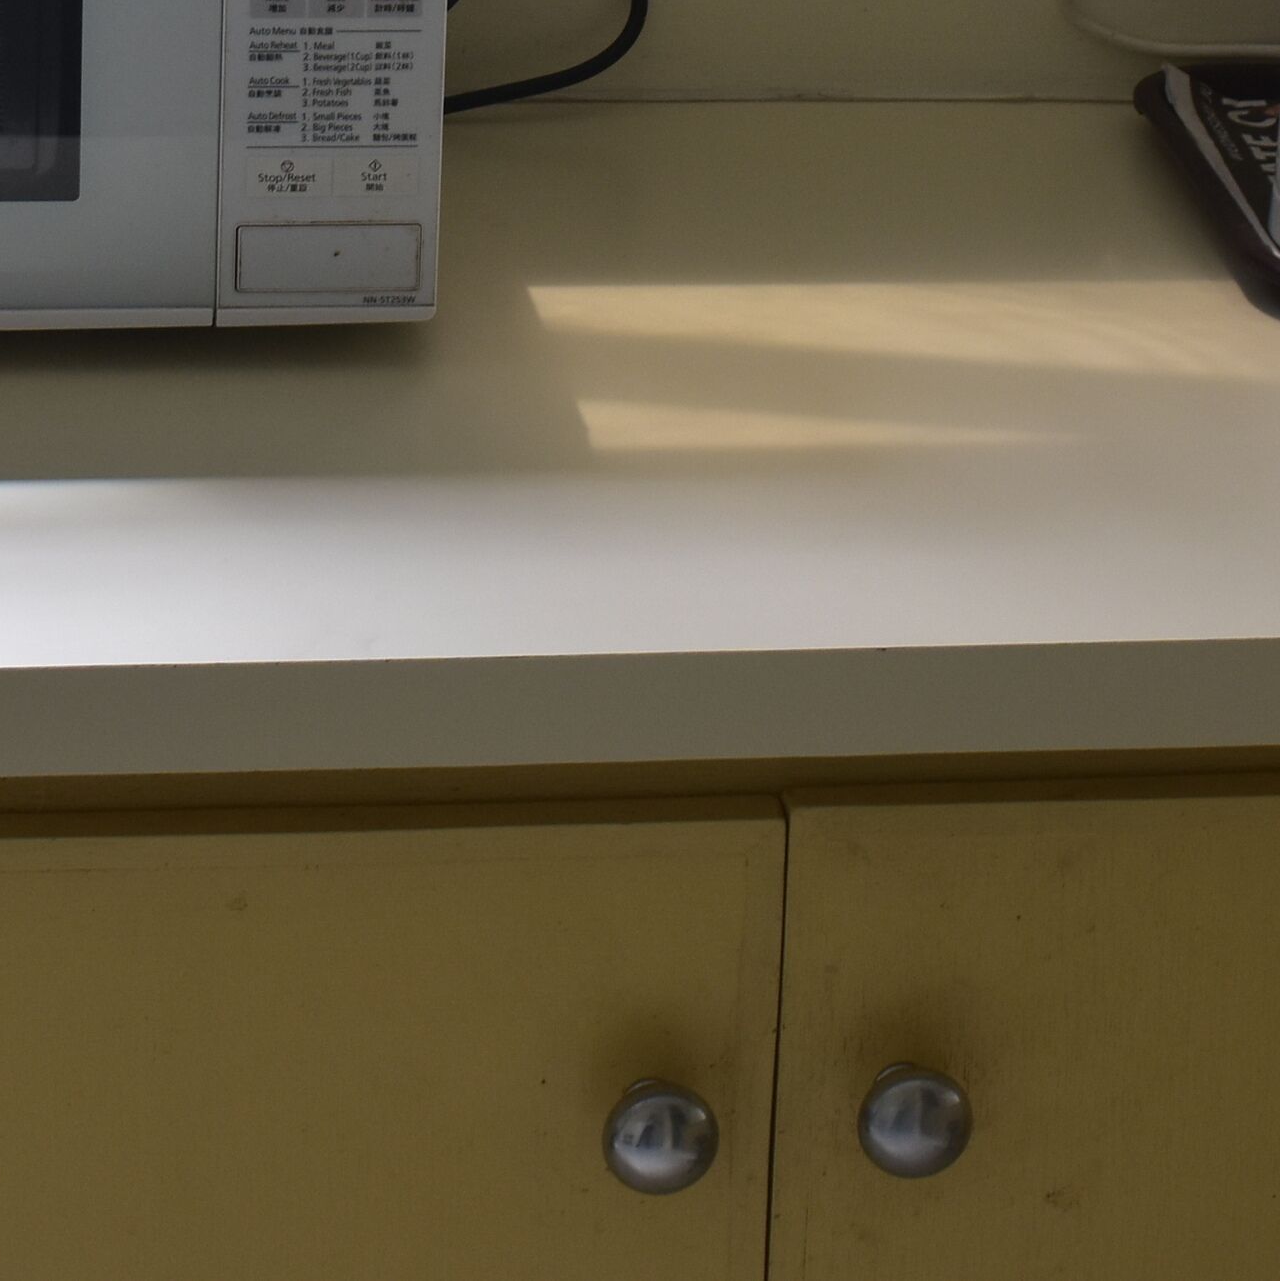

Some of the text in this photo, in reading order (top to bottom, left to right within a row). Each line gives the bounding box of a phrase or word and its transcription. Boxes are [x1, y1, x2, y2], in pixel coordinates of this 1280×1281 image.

[250, 27, 270, 36] Auto
[272, 27, 296, 36] Menu
[303, 53, 311, 61] 2.
[303, 63, 311, 71] 3.
[303, 77, 310, 85] 1.
[313, 77, 331, 85] Fresh
[334, 77, 371, 87] Vegetables
[302, 88, 310, 96] 2.
[312, 88, 333, 96] Fresh
[336, 88, 352, 96] Fish
[302, 99, 310, 107] 3.
[313, 112, 335, 120] Small
[337, 112, 362, 120] Pieces
[301, 123, 310, 132] 2.
[313, 123, 327, 133] Big
[328, 123, 353, 131] Pieces
[301, 134, 309, 142] 3.
[312, 133, 360, 142] Bread/Cake
[258, 173, 316, 184] Stop/Reset
[361, 172, 387, 181] Start
